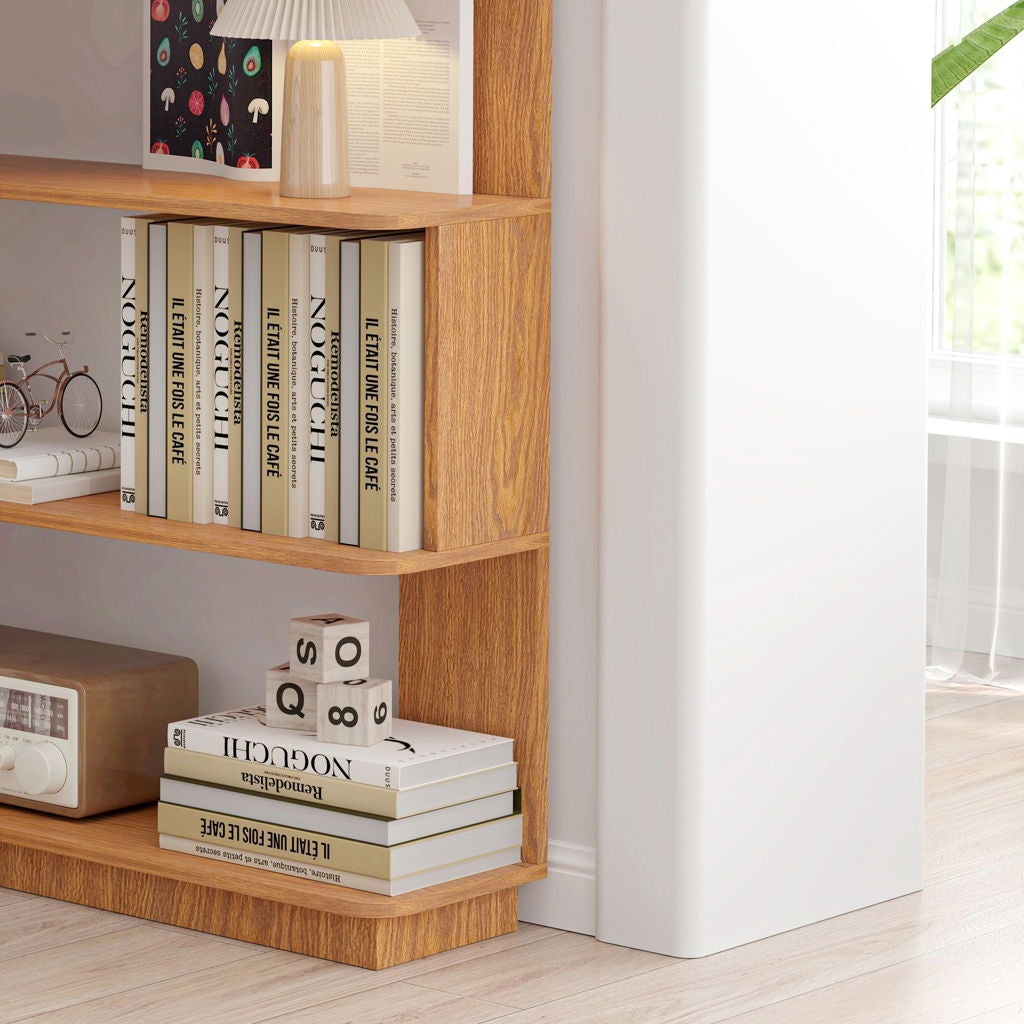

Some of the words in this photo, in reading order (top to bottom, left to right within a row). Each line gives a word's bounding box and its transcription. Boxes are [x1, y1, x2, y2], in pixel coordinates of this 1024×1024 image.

[365, 317, 379, 330] IL
[365, 334, 382, 371] ÉTAIT
[309, 295, 326, 463] NOGUCHI
[365, 374, 379, 401] UNE
[365, 404, 379, 434] FOIS
[365, 438, 379, 454] LE
[365, 456, 381, 492] CAFÉ
[275, 681, 306, 719] Q
[222, 736, 352, 781] NOGUCHI
[240, 771, 324, 800] Remodelista
